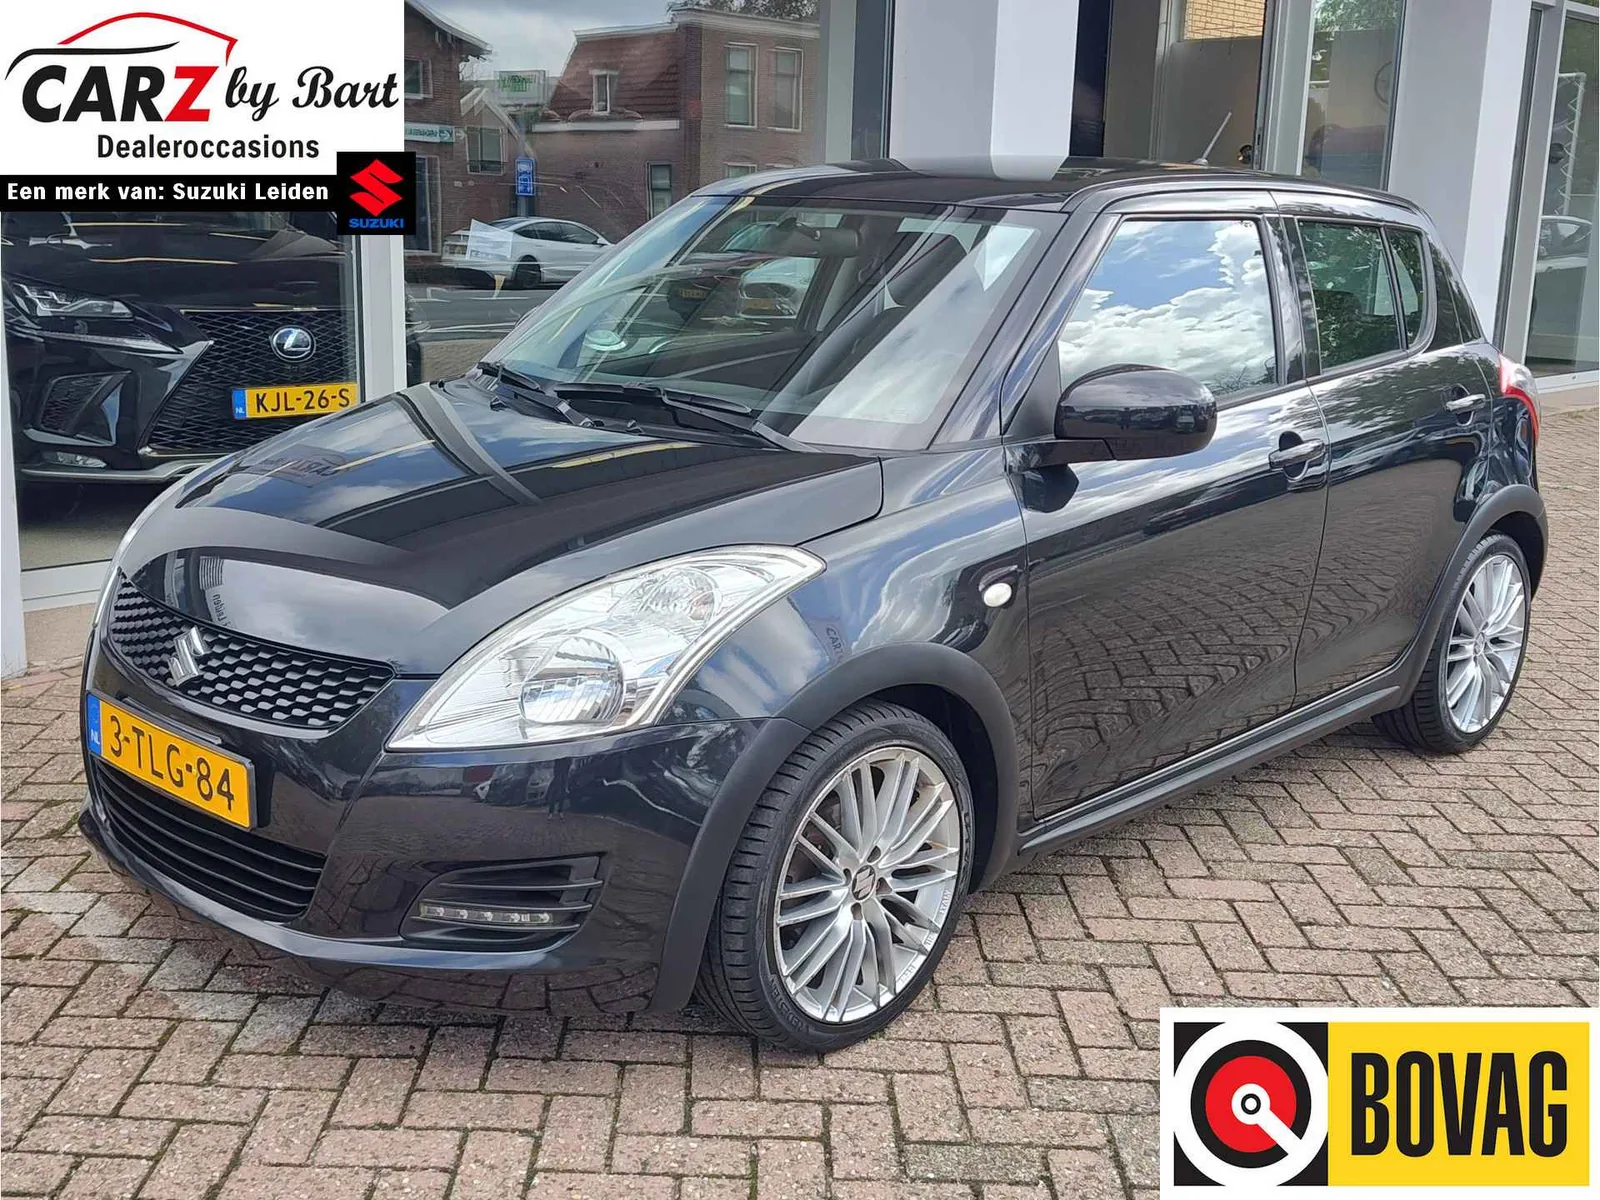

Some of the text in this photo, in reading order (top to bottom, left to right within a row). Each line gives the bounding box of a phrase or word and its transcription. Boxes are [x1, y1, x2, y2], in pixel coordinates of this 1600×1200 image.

[235, 388, 350, 414] NL KJL-26-S
[90, 715, 235, 812] NL 3-TLG-84
